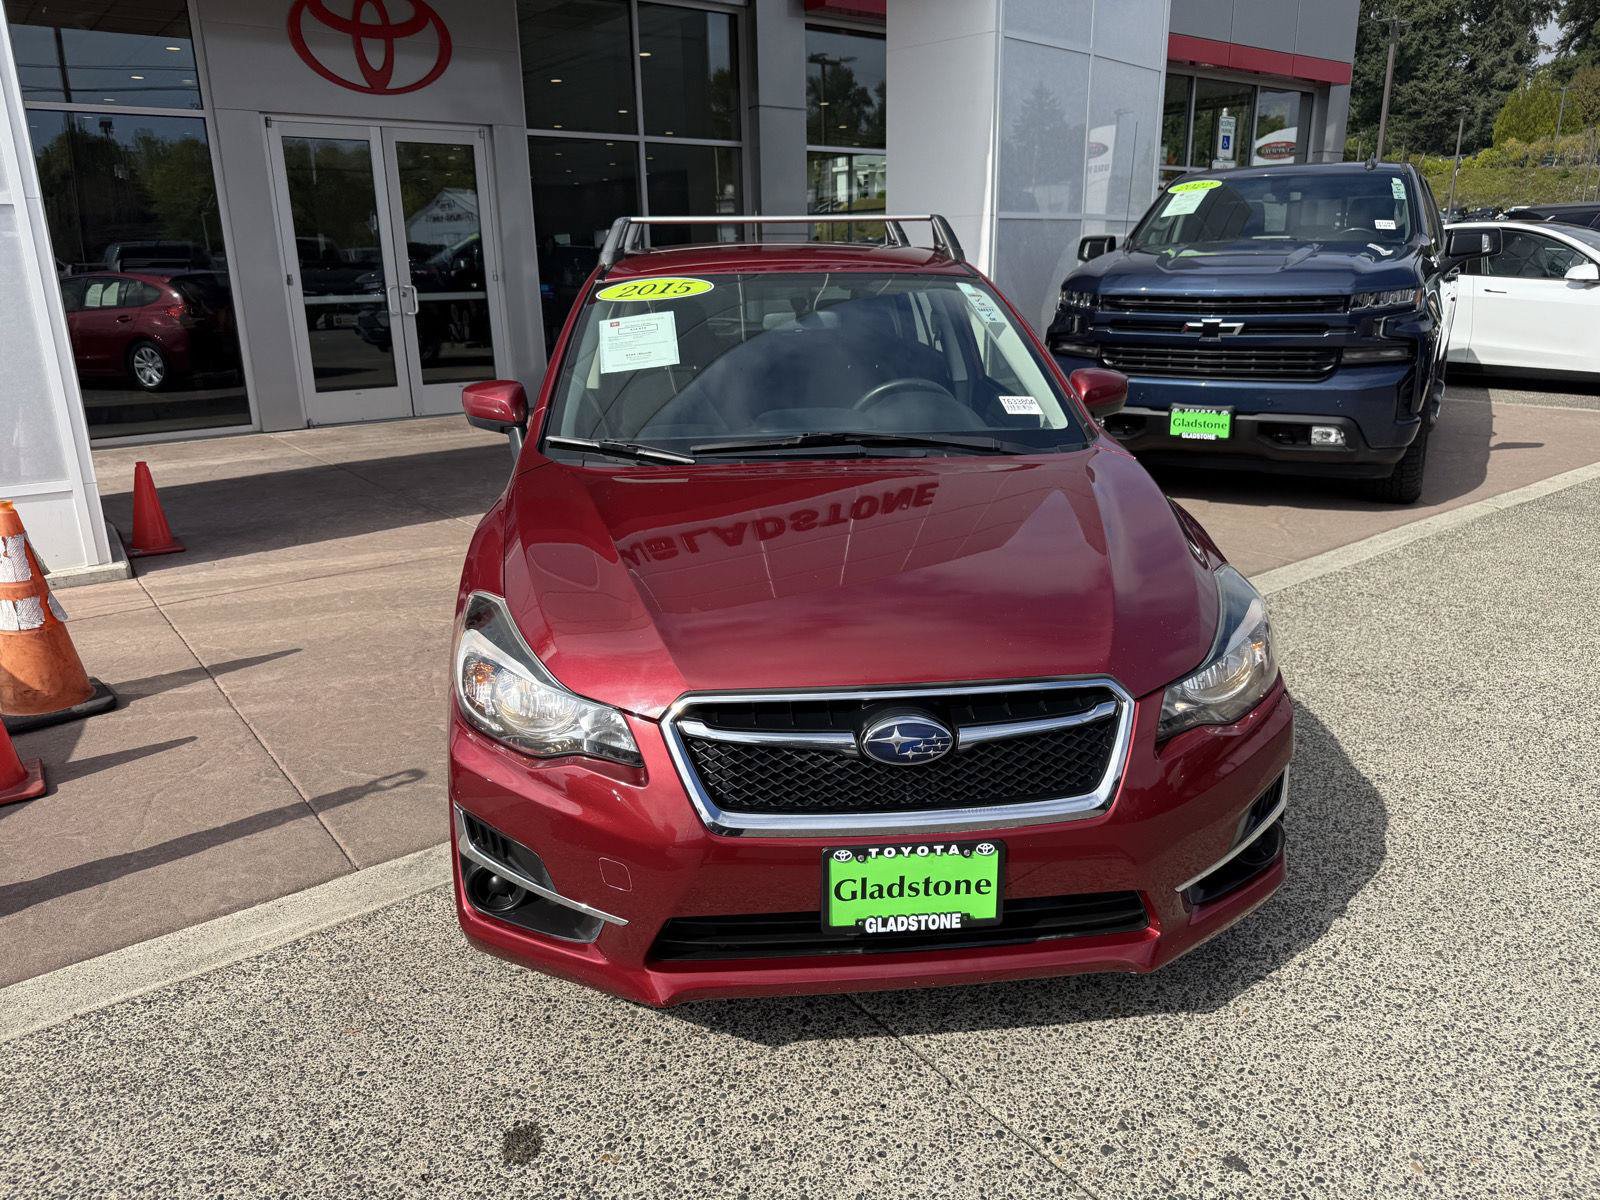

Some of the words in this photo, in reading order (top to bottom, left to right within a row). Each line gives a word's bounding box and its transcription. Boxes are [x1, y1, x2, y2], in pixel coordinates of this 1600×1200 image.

[616, 282, 695, 298] 2015
[1172, 418, 1228, 430] Gladstone
[1181, 432, 1216, 440] GLADSTONE
[868, 844, 960, 859] TOYOTA
[833, 875, 992, 902] Gladstone
[865, 912, 962, 934] GLADSTONE
